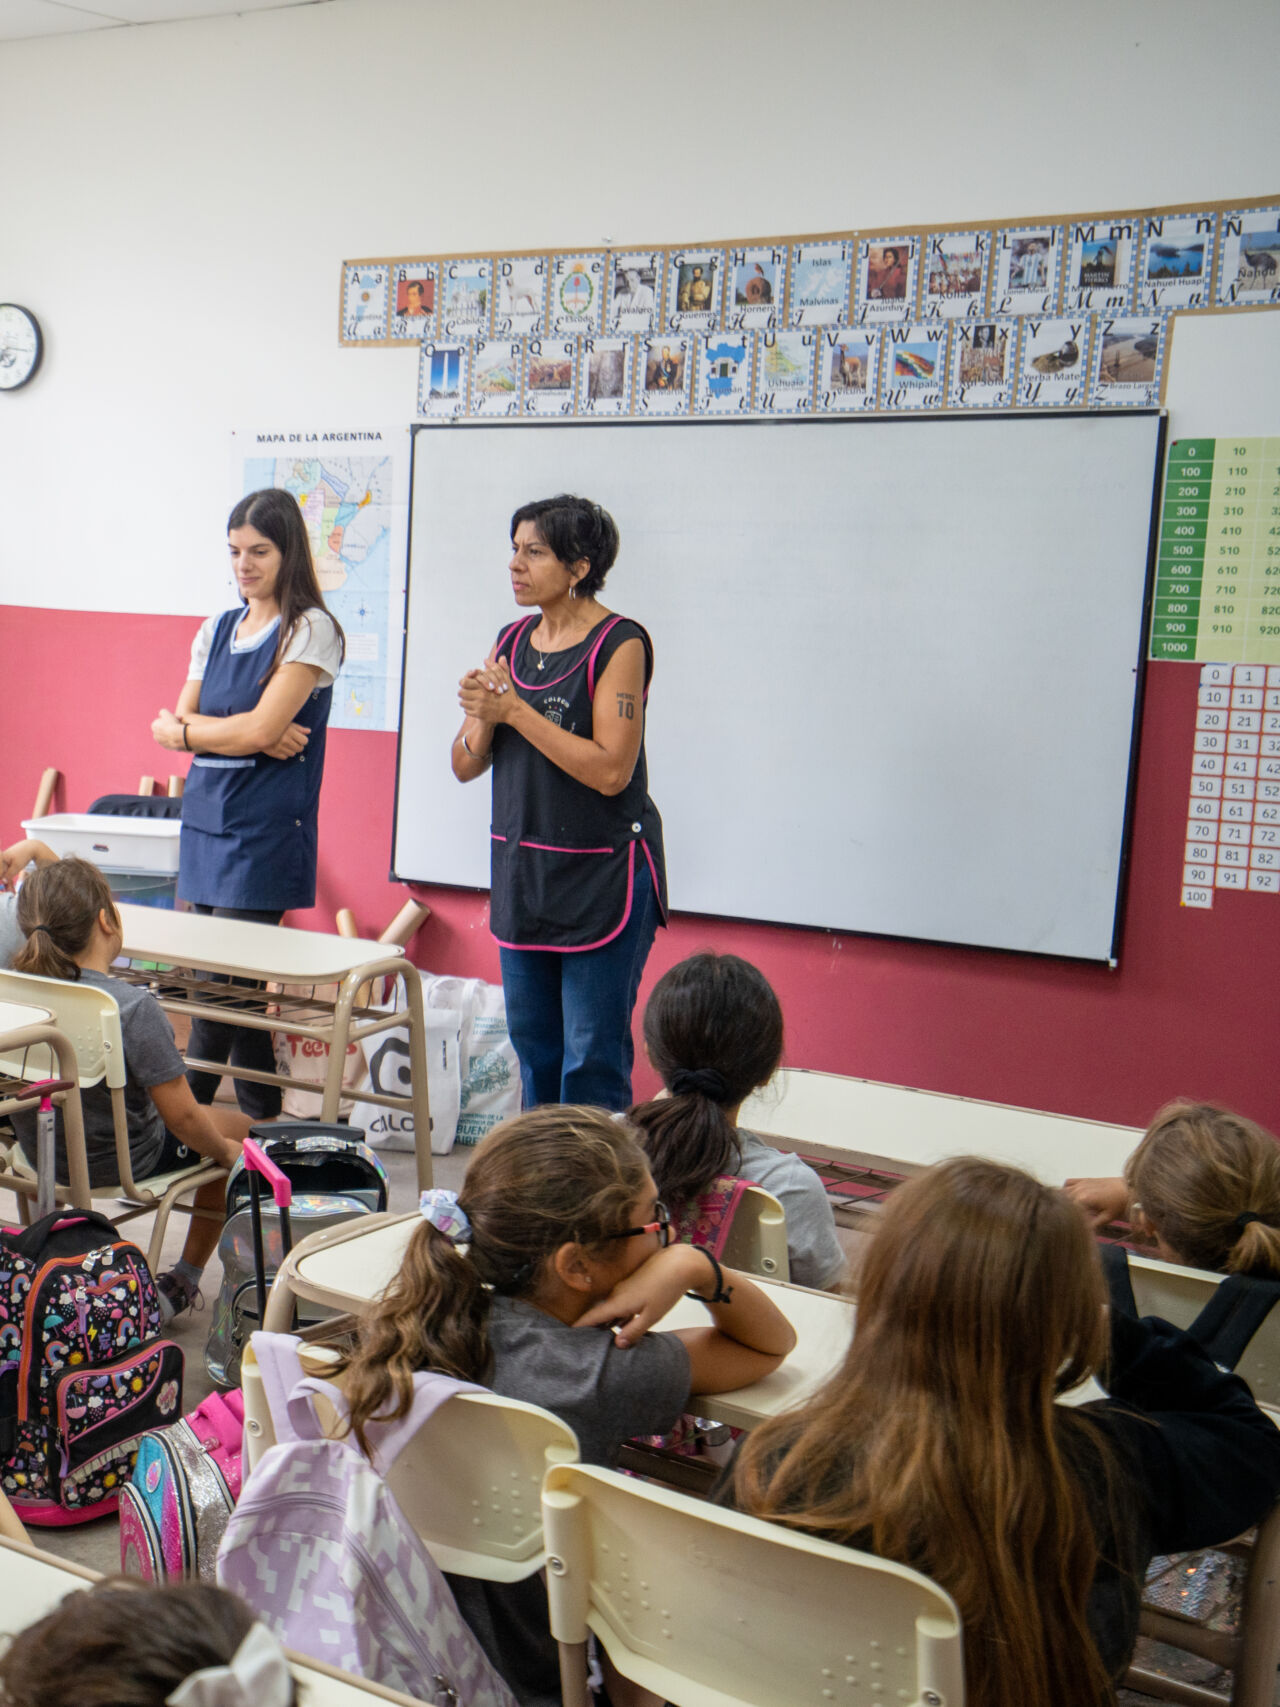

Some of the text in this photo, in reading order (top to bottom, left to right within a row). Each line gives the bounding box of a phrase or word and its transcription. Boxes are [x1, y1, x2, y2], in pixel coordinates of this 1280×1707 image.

[1148, 219, 1211, 238] N n
[1226, 215, 1241, 237] Ñ
[1075, 225, 1131, 243] M m
[933, 235, 984, 254] K k
[1002, 235, 1011, 249] L
[842, 246, 845, 261] i
[863, 240, 915, 259] J j
[649, 254, 657, 270] f
[674, 254, 718, 271] G g
[734, 250, 780, 266] H h
[399, 267, 434, 282] B b
[449, 265, 486, 279] C c
[502, 260, 543, 276] D d
[556, 261, 600, 275] E e
[352, 272, 382, 284] A a
[1144, 279, 1175, 288] Nahuel
[740, 305, 776, 313] Hornero
[800, 298, 839, 306] Malvinas
[959, 326, 1009, 341] X x
[1030, 322, 1081, 340] Y y
[1102, 320, 1159, 336] Z z
[703, 335, 747, 349] T t
[764, 333, 812, 348] U u
[827, 333, 875, 347] V v
[891, 328, 943, 343] W w
[425, 344, 465, 357] O o
[477, 342, 520, 358] P p
[530, 341, 573, 356] Q q
[585, 340, 628, 353] R r
[643, 338, 687, 352] S s
[768, 379, 803, 388] Ushuaia
[1023, 372, 1080, 381] Yerba Mate
[899, 380, 938, 390] Whipala
[257, 432, 382, 443] MAPA DE LA ARGENTINA
[1188, 448, 1246, 457] 0 10
[1181, 467, 1247, 476] 100 110
[1178, 487, 1245, 496] 200 210
[1177, 507, 1244, 515] 300 310
[1174, 526, 1241, 535] 400 410
[1173, 546, 1239, 555] 500 510
[1171, 566, 1238, 575] 600 610
[1170, 585, 1236, 594] 700 710
[1168, 604, 1187, 613] 800
[1214, 606, 1234, 614] 810
[1166, 624, 1186, 632] 900
[1212, 625, 1232, 633] 910
[1162, 643, 1187, 652] 1000
[1212, 670, 1251, 681] 0 1
[1208, 693, 1253, 704] 10 11
[617, 700, 634, 720] 10
[1205, 715, 1251, 727] 20 21
[1202, 738, 1249, 749] 30 31
[1201, 760, 1247, 772] 40 41
[1199, 783, 1279, 796] 50 51 52
[1197, 804, 1278, 819] 60 61 62
[1195, 827, 1276, 841] 70 71 72
[1193, 849, 1273, 864] 80 81 82
[1191, 871, 1271, 886] 90 91 92
[1187, 892, 1206, 901] 100
